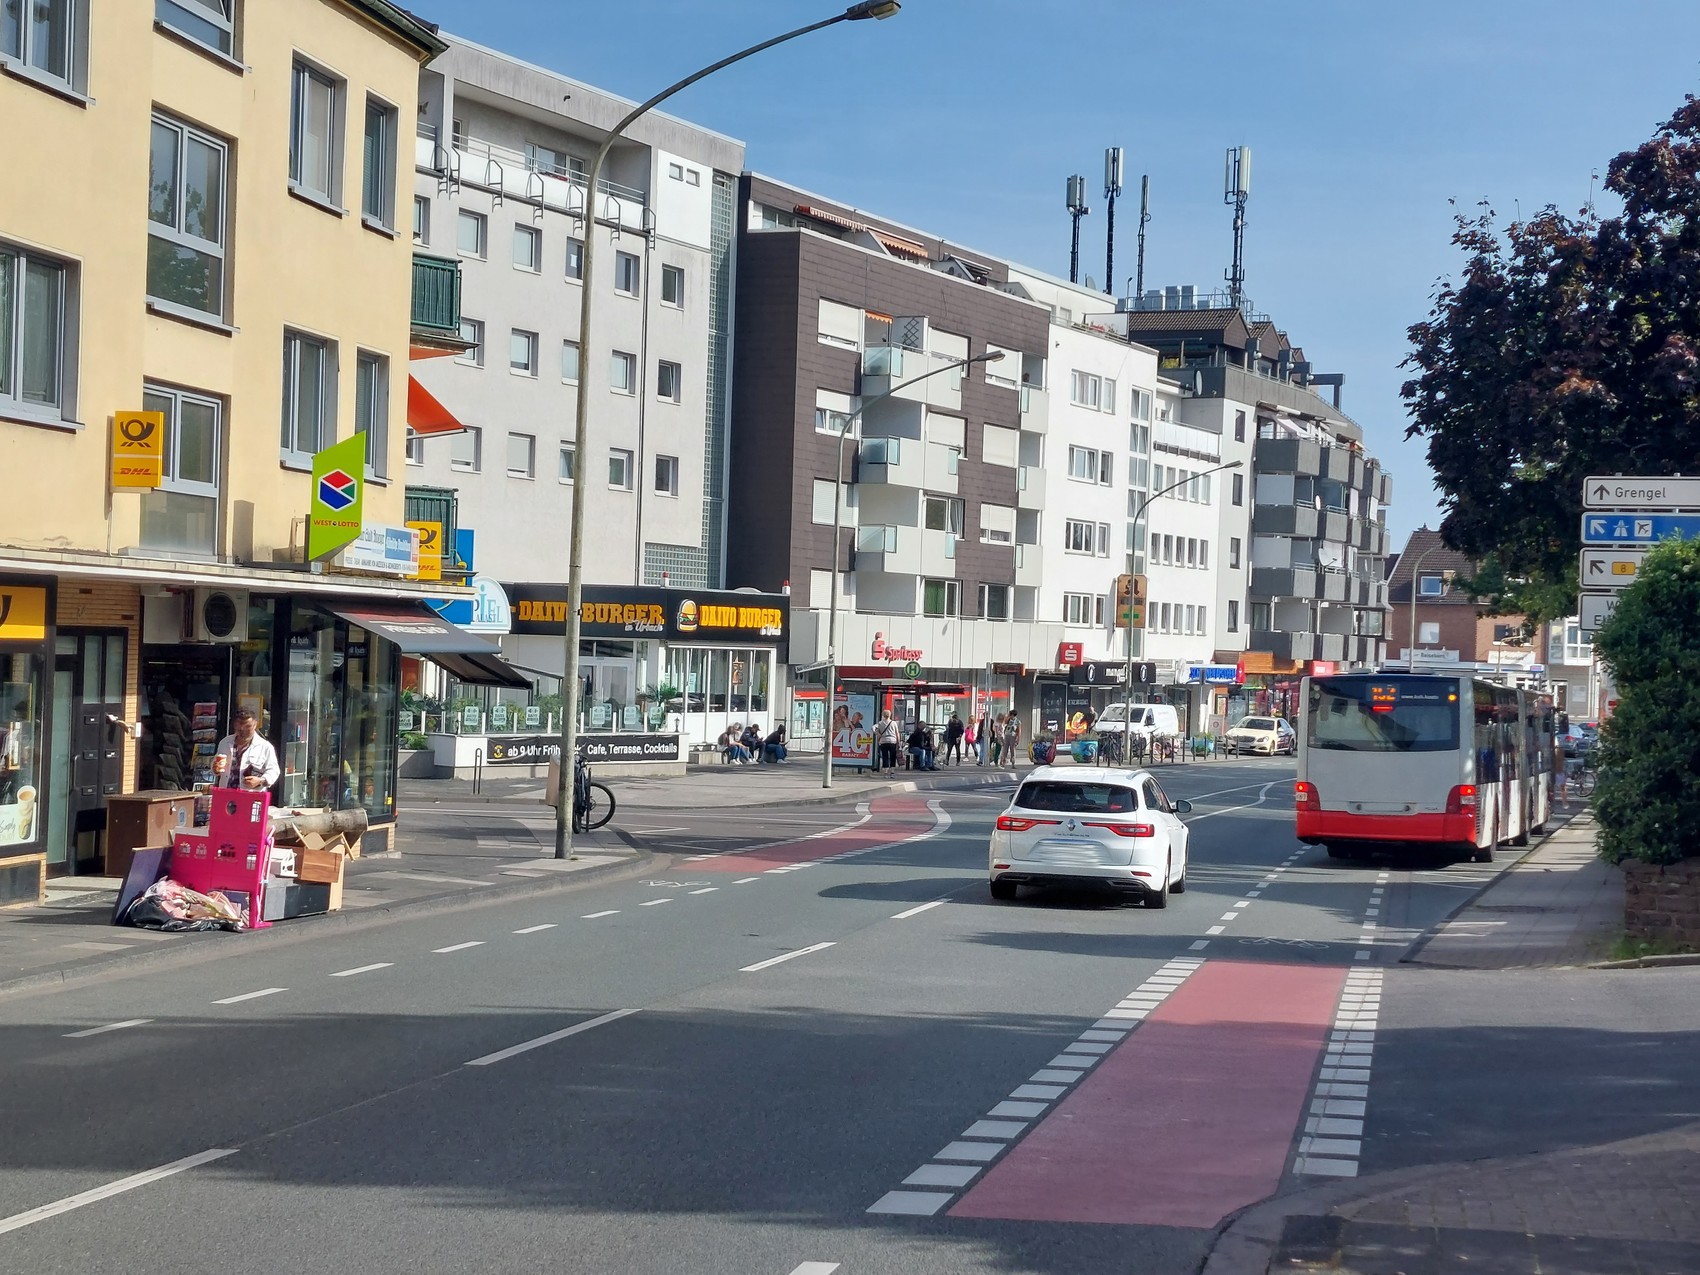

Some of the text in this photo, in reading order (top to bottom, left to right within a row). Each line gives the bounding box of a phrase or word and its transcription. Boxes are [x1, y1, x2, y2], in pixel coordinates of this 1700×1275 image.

[120, 467, 151, 475] DHL
[1615, 487, 1666, 500] Grengel
[1620, 564, 1627, 573] 8
[519, 601, 665, 625] DAIV BURGER
[699, 605, 782, 629] DAIVO BURGER
[885, 645, 923, 663] Sparkasse
[909, 665, 917, 674] H
[508, 745, 519, 757] ab
[520, 745, 526, 756] 9
[527, 744, 542, 756] Uhr
[588, 743, 607, 756] Cafe,
[608, 743, 643, 755] Terrasse,
[644, 742, 678, 754] Cocktails
